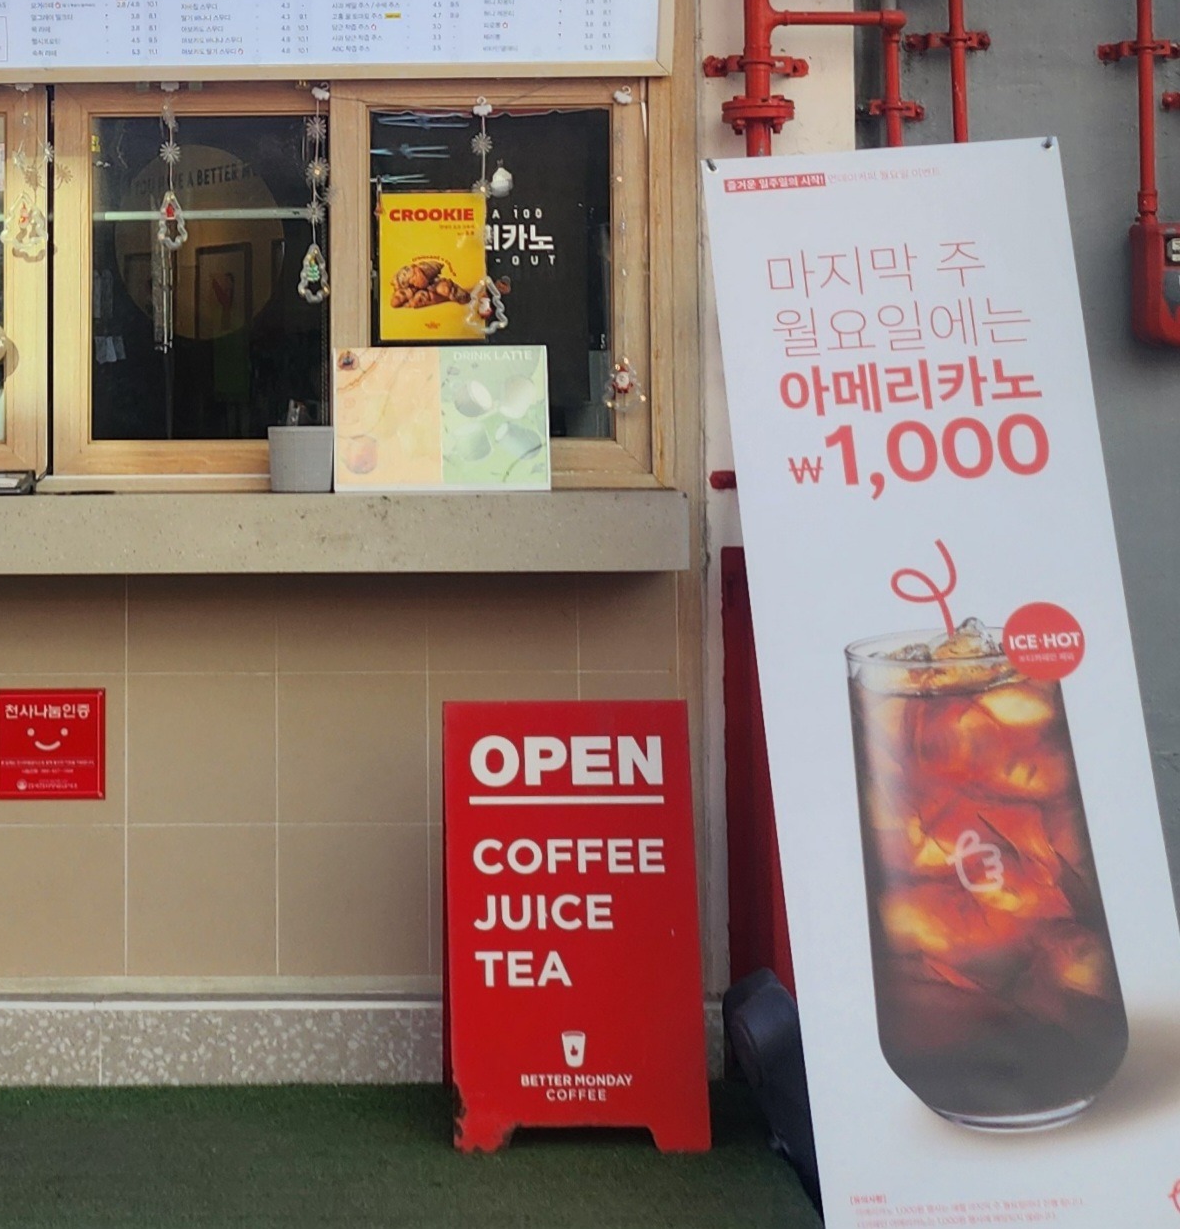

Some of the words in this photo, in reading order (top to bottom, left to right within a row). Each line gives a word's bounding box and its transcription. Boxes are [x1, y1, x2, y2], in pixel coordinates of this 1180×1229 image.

[196, 162, 237, 185] BETTER
[726, 179, 756, 192] 즐거운
[759, 177, 798, 190] 일주일의
[801, 175, 825, 187] 시작!
[389, 208, 474, 221] CROOKIE
[766, 242, 918, 299] 마지막
[936, 241, 985, 288] 주
[772, 297, 1031, 358] 월요일에는
[453, 351, 491, 361] DRINK
[494, 350, 532, 360] LATTE
[779, 356, 1043, 417] 아메리카노
[470, 735, 664, 787] OPEN
[473, 839, 665, 875] COFFEE
[474, 894, 614, 930] JUICE
[474, 951, 572, 987] TEA
[521, 1074, 571, 1087] BETTER
[575, 1074, 633, 1087] MONDAY
[546, 1089, 607, 1101] COFFEE
